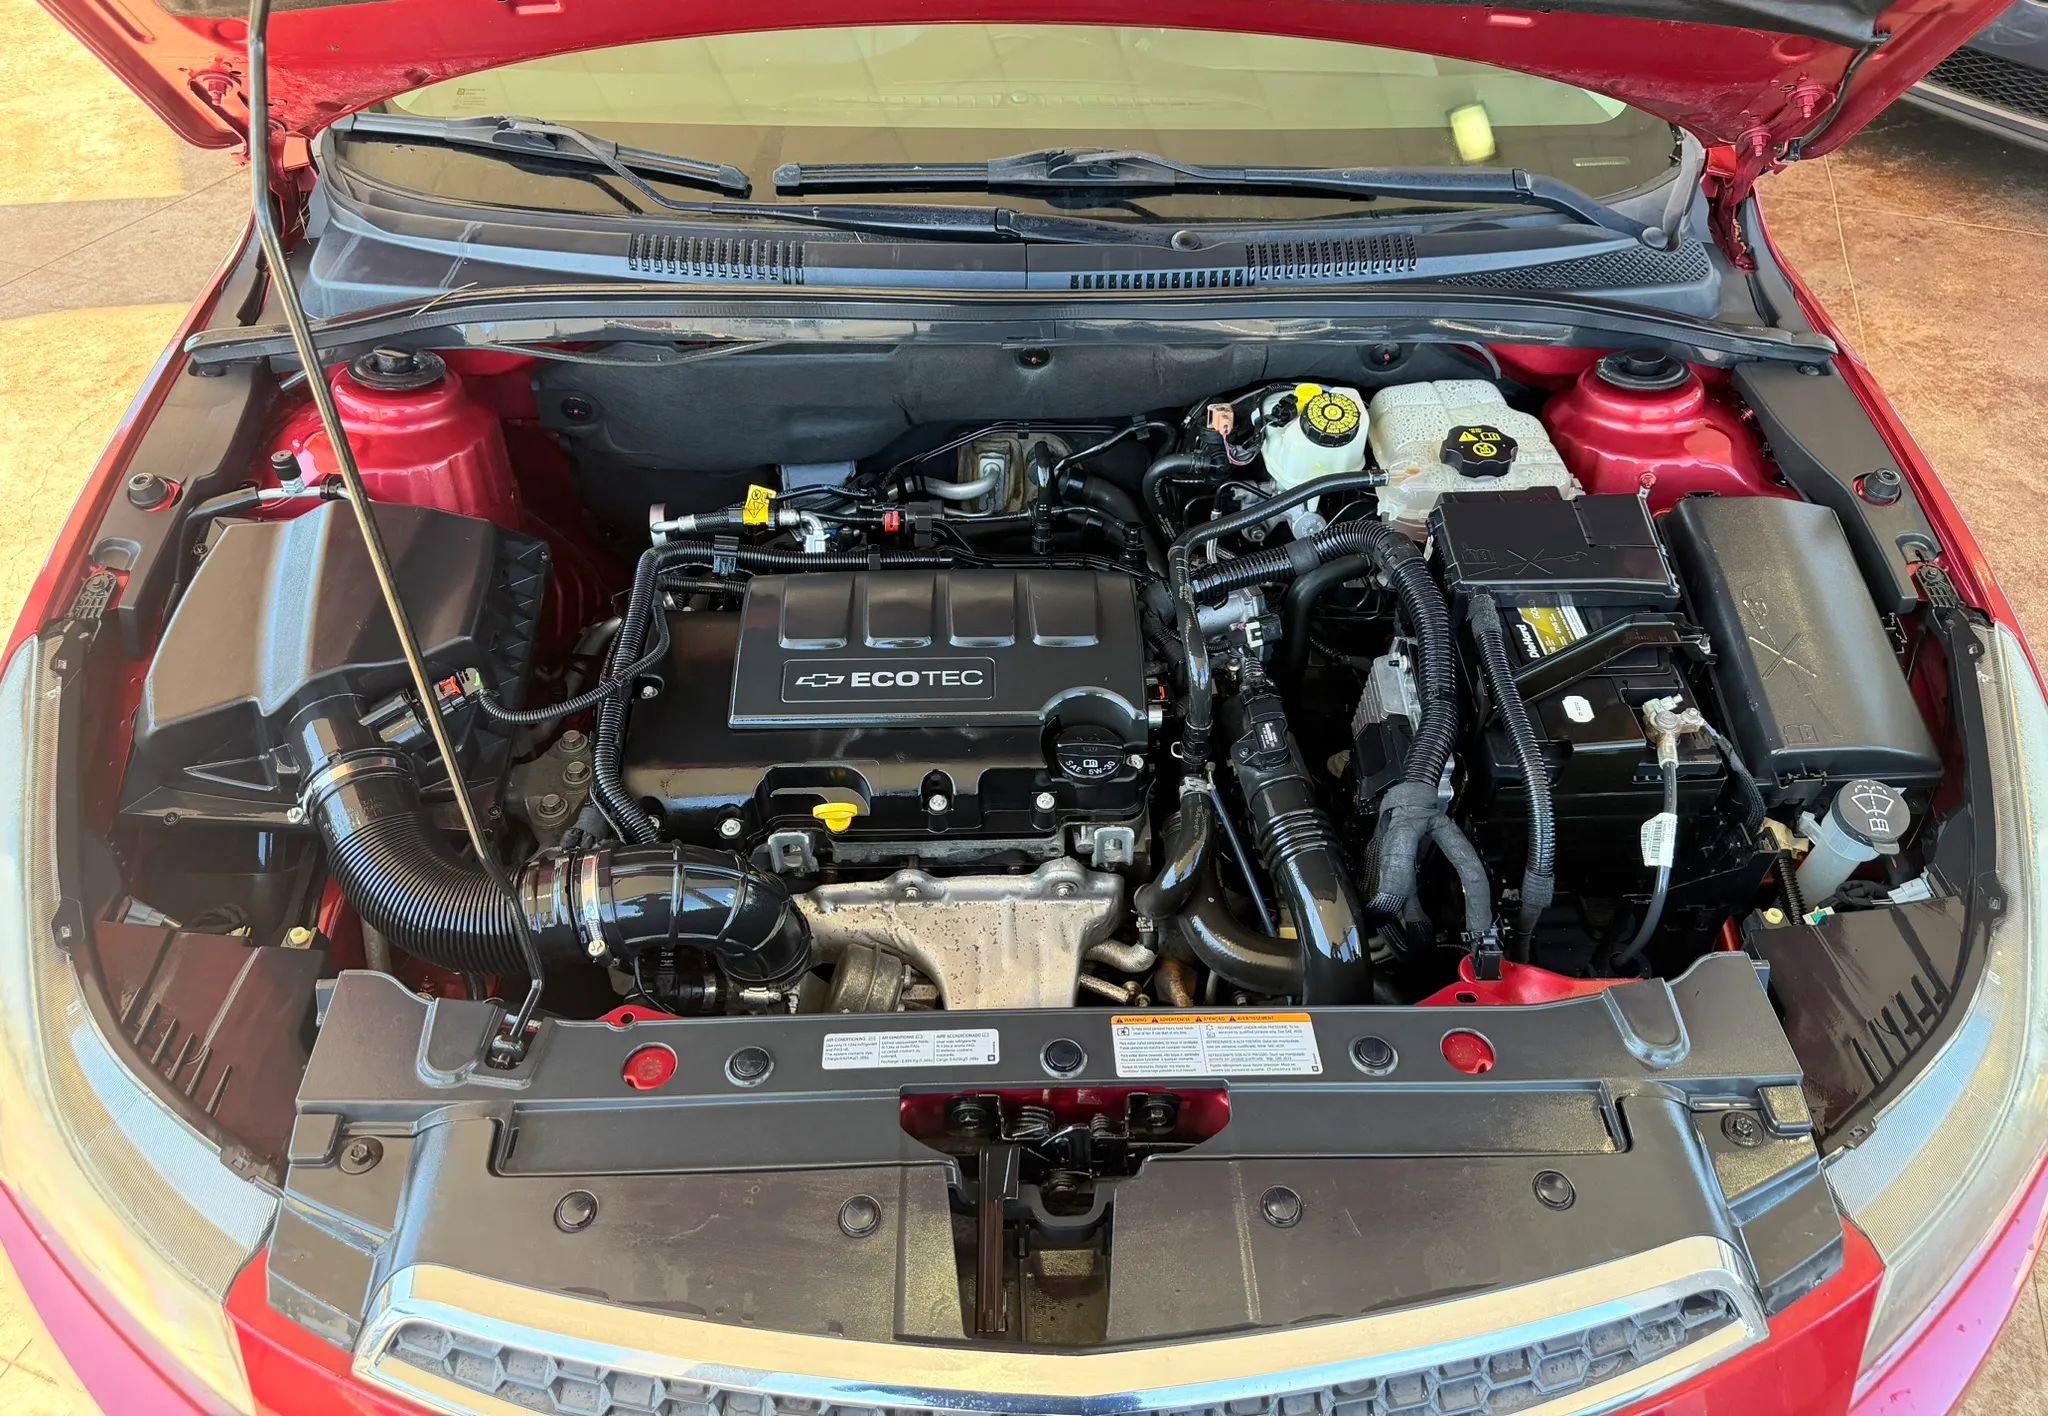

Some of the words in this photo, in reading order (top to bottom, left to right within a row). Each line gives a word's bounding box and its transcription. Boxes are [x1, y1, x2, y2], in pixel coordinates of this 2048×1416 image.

[1515, 624, 1541, 658] DieHard
[851, 670, 984, 688] ECOTEC
[1065, 760, 1083, 773] SAE
[1088, 760, 1116, 775] 5W-30
